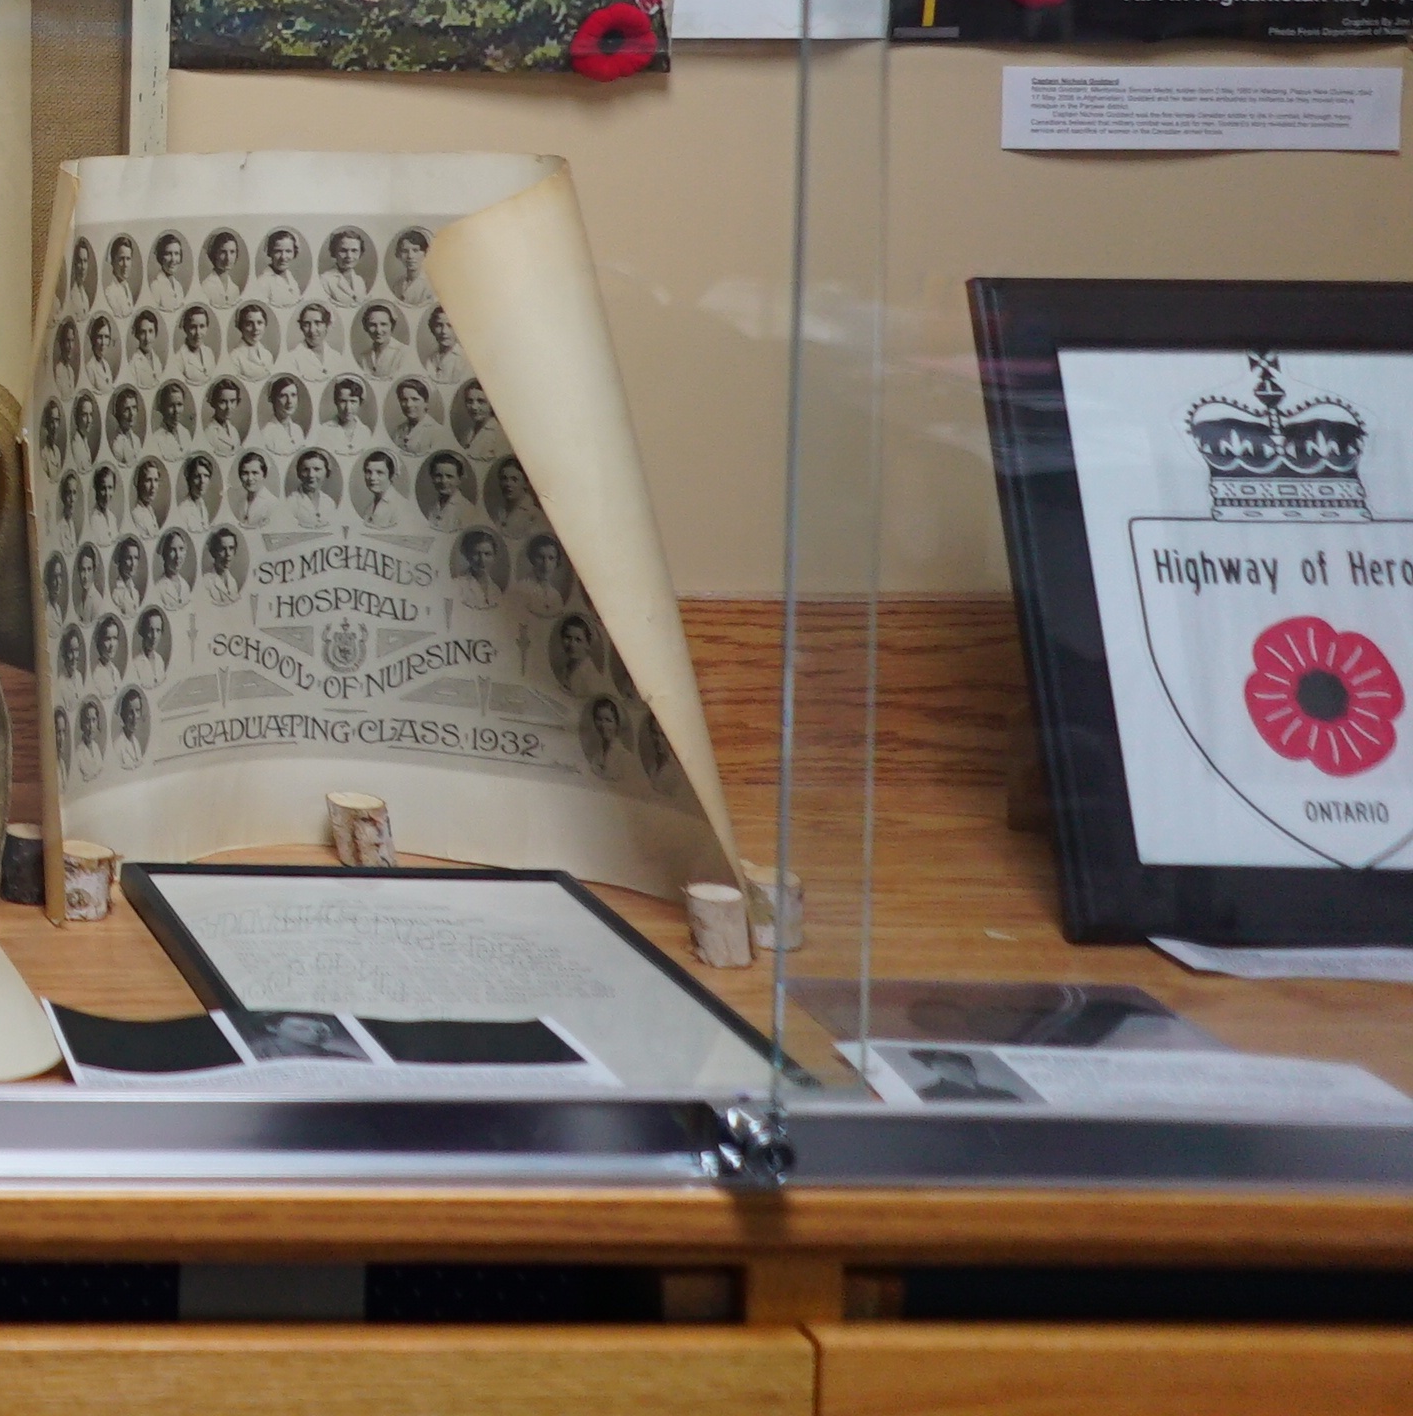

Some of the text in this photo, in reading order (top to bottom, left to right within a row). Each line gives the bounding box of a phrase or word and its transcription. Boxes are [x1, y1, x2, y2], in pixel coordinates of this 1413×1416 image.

[1153, 548, 1279, 596] Highway
[1300, 549, 1329, 586] of
[274, 587, 419, 622] HOSPITAL
[212, 634, 496, 700] SCHOOL OF NURSING
[183, 712, 352, 750] GRADUATING
[469, 727, 542, 759] 1932
[1304, 799, 1390, 825] ONTARIO
